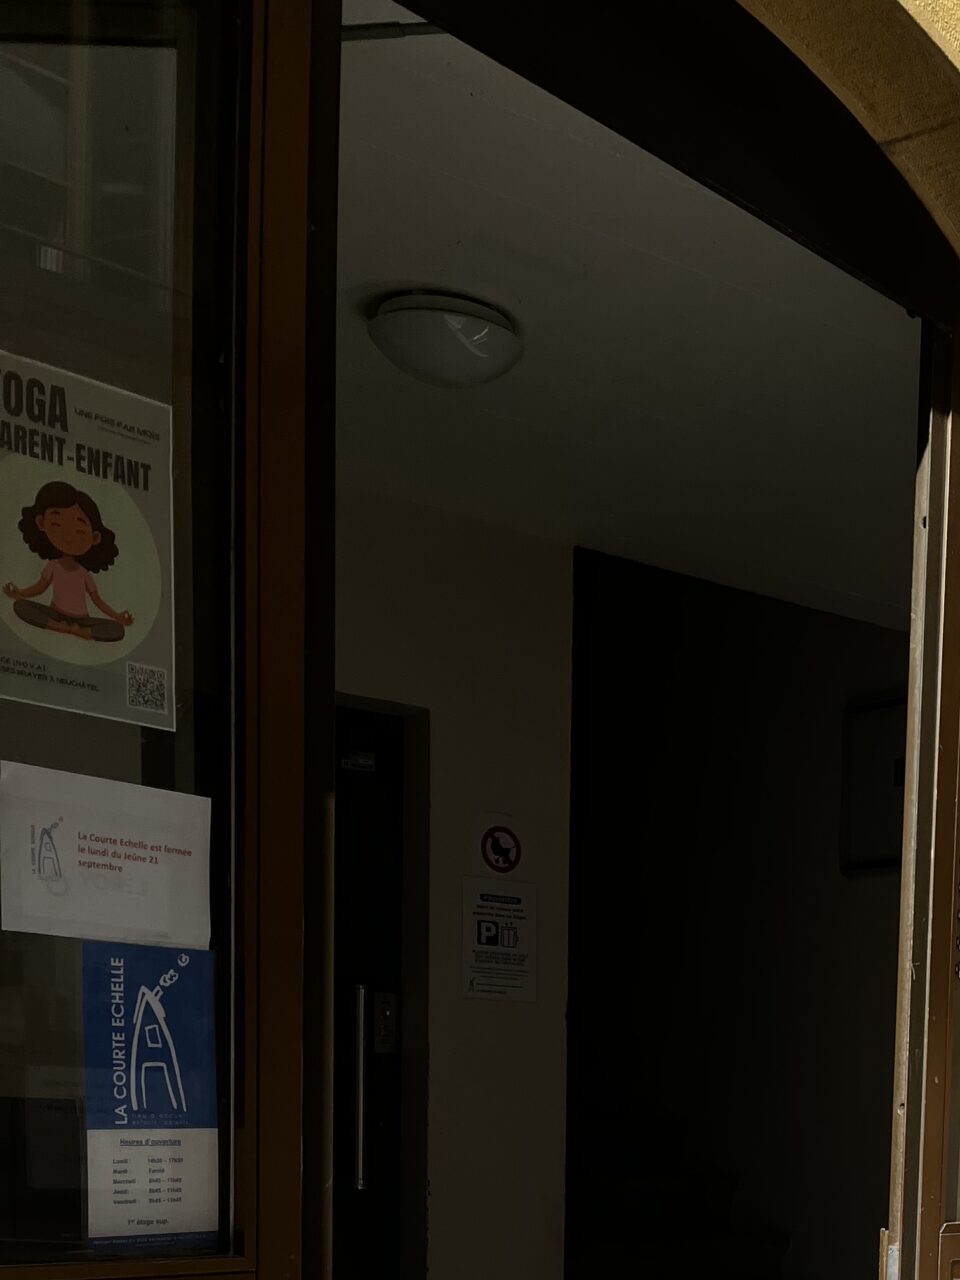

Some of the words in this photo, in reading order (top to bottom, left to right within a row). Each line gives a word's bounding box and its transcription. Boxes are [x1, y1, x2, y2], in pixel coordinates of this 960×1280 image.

[0, 370, 69, 433] OGA
[78, 831, 88, 841] La
[89, 833, 118, 847] Courte
[119, 838, 149, 851] Echelle
[150, 843, 163, 853] est
[164, 845, 193, 858] fermée
[78, 844, 86, 854] le
[87, 845, 109, 857] lundi
[111, 849, 122, 860] du
[148, 856, 159, 865] 21
[78, 859, 123, 873] septembre
[110, 957, 125, 1027] ECHELLE
[111, 1032, 127, 1099] COURTE
[114, 1104, 128, 1125] LA
